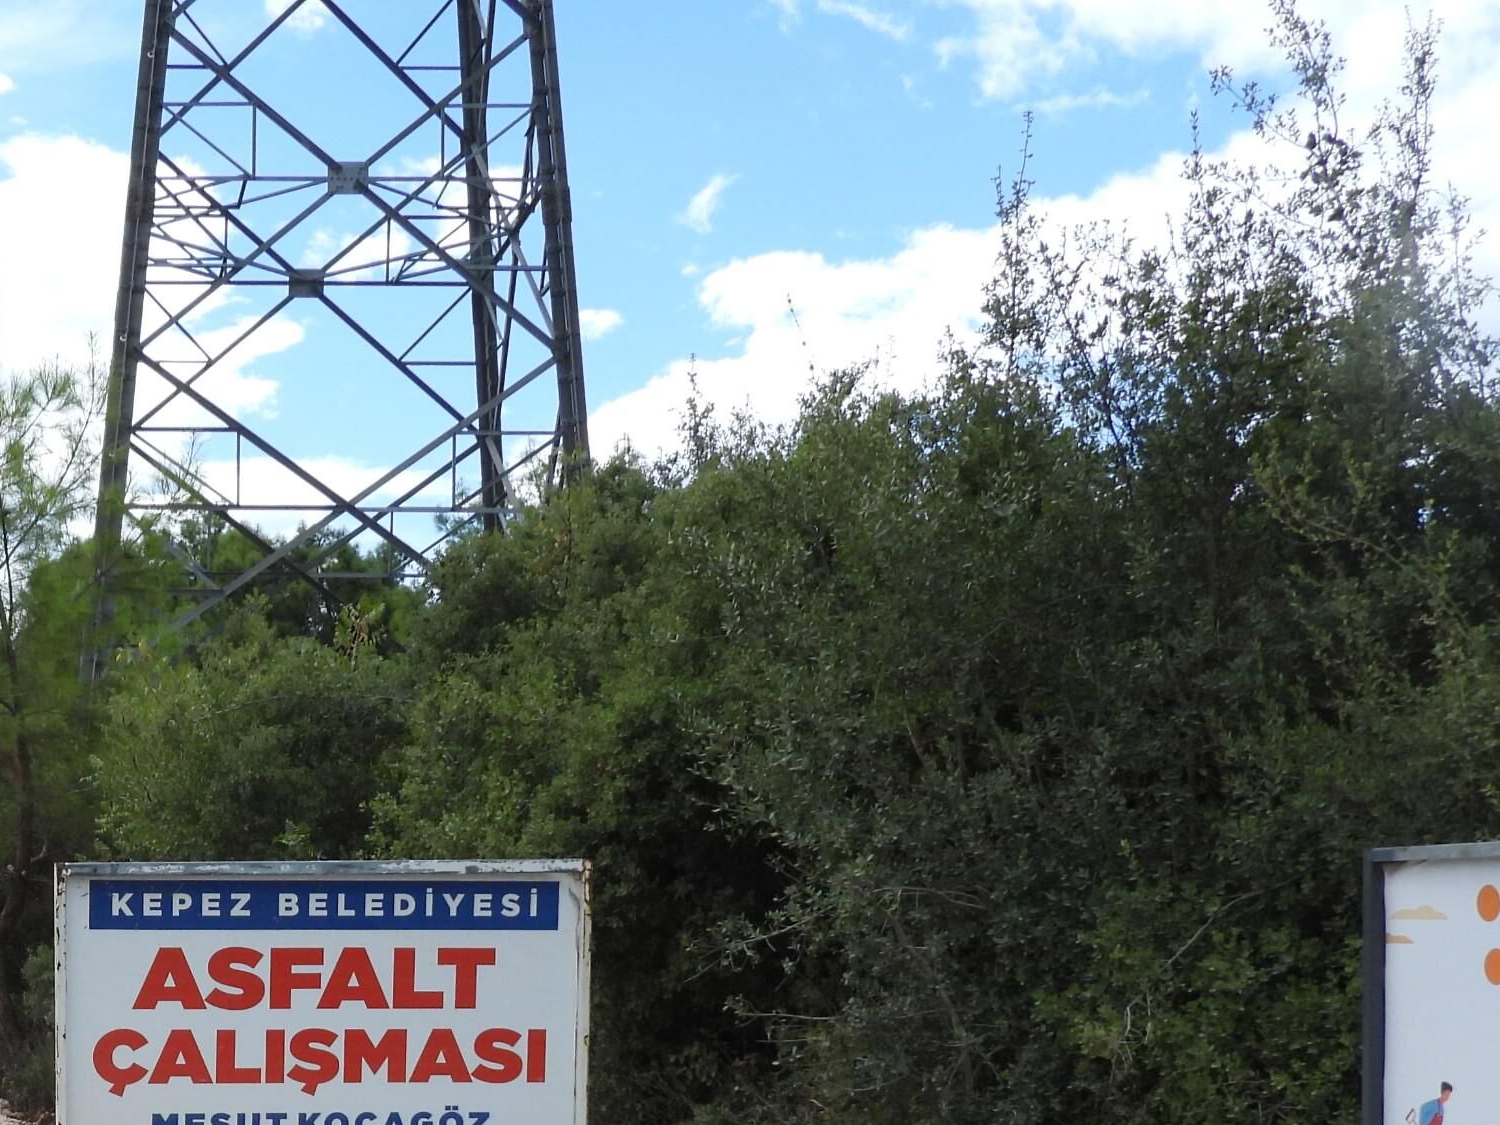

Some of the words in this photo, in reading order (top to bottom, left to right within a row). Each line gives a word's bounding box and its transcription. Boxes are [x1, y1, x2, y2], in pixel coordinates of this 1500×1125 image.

[111, 892, 251, 917] KEPEZ
[278, 887, 538, 917] BELEDİYESİ
[132, 947, 496, 1010] ASFALT
[93, 1028, 547, 1097] ÇALIŞMASI
